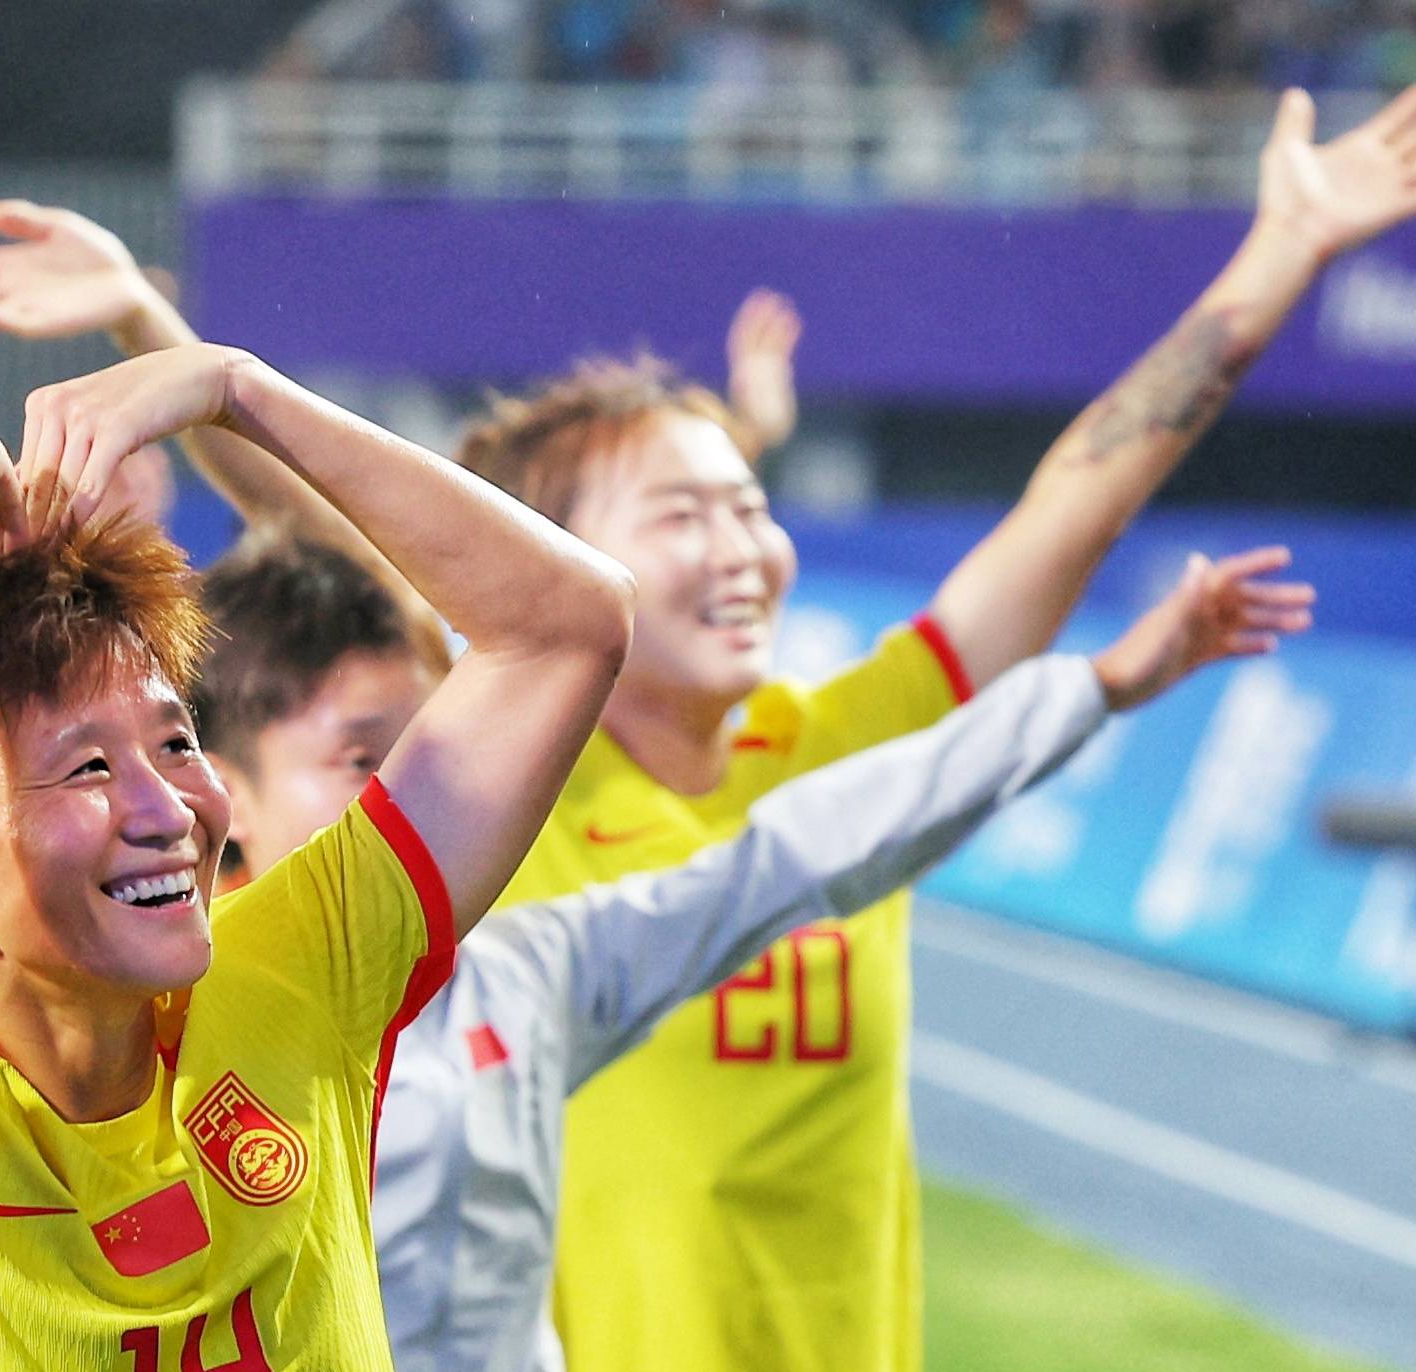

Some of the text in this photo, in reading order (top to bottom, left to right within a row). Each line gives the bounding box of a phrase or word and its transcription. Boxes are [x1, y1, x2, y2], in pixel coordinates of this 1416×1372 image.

[713, 925, 851, 1063] 20
[193, 1087, 245, 1146] CFA
[219, 1118, 243, 1142] 中国
